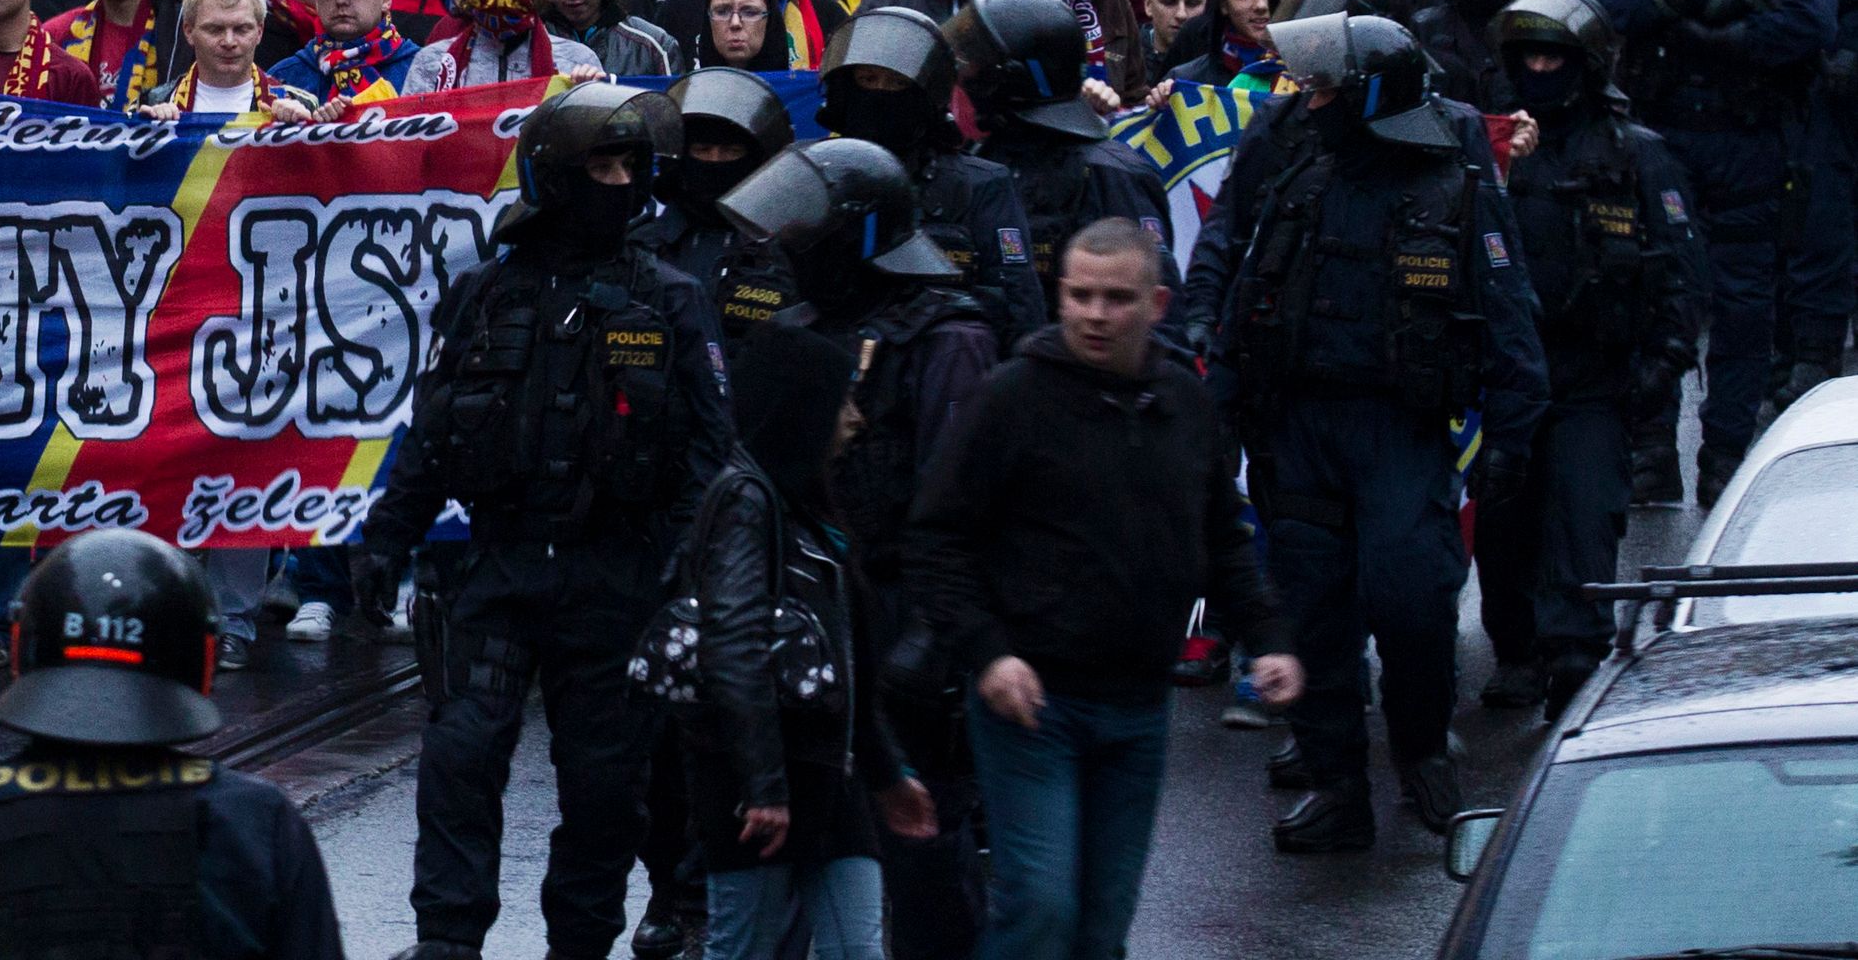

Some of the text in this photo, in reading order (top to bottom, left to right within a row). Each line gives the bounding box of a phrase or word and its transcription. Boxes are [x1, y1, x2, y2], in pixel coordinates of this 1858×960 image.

[1397, 254, 1451, 270] POLICIE
[606, 331, 664, 346] POLICIE
[63, 612, 144, 643] B 112
